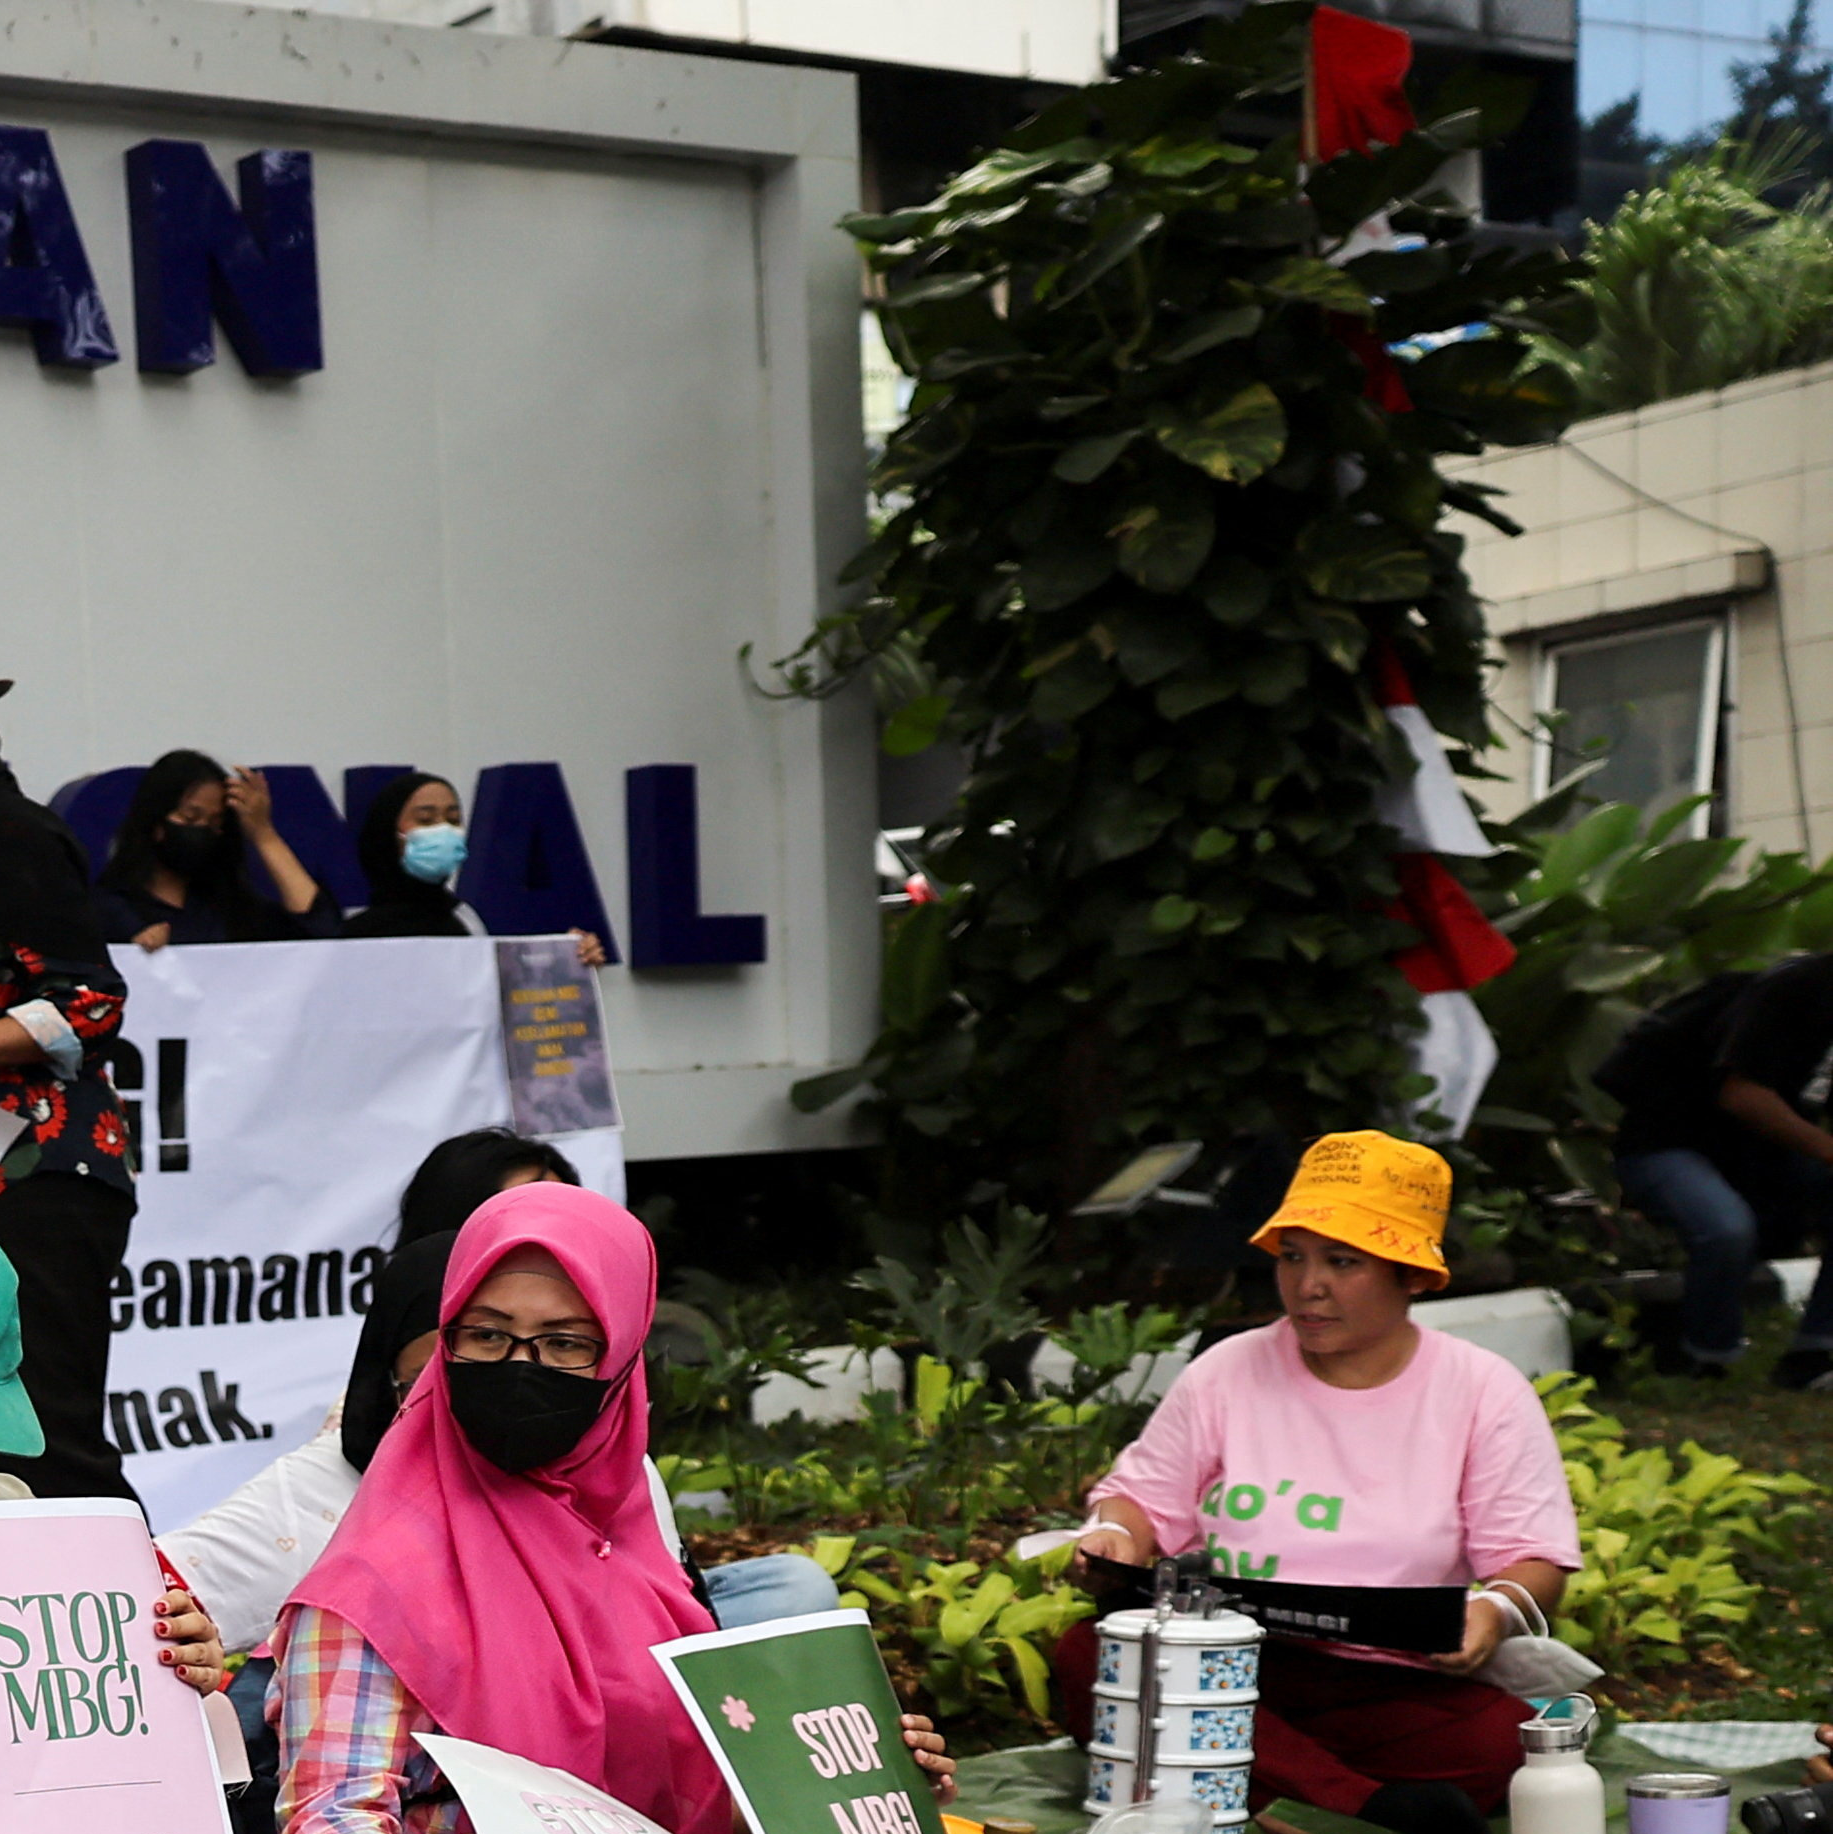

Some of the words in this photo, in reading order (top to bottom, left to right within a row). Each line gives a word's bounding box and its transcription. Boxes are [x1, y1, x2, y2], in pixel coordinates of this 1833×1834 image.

[109, 1245, 387, 1332] eamana
[108, 1370, 274, 1456] nak.
[0, 1664, 149, 1744] MBG!
[792, 1702, 884, 1779] STOP
